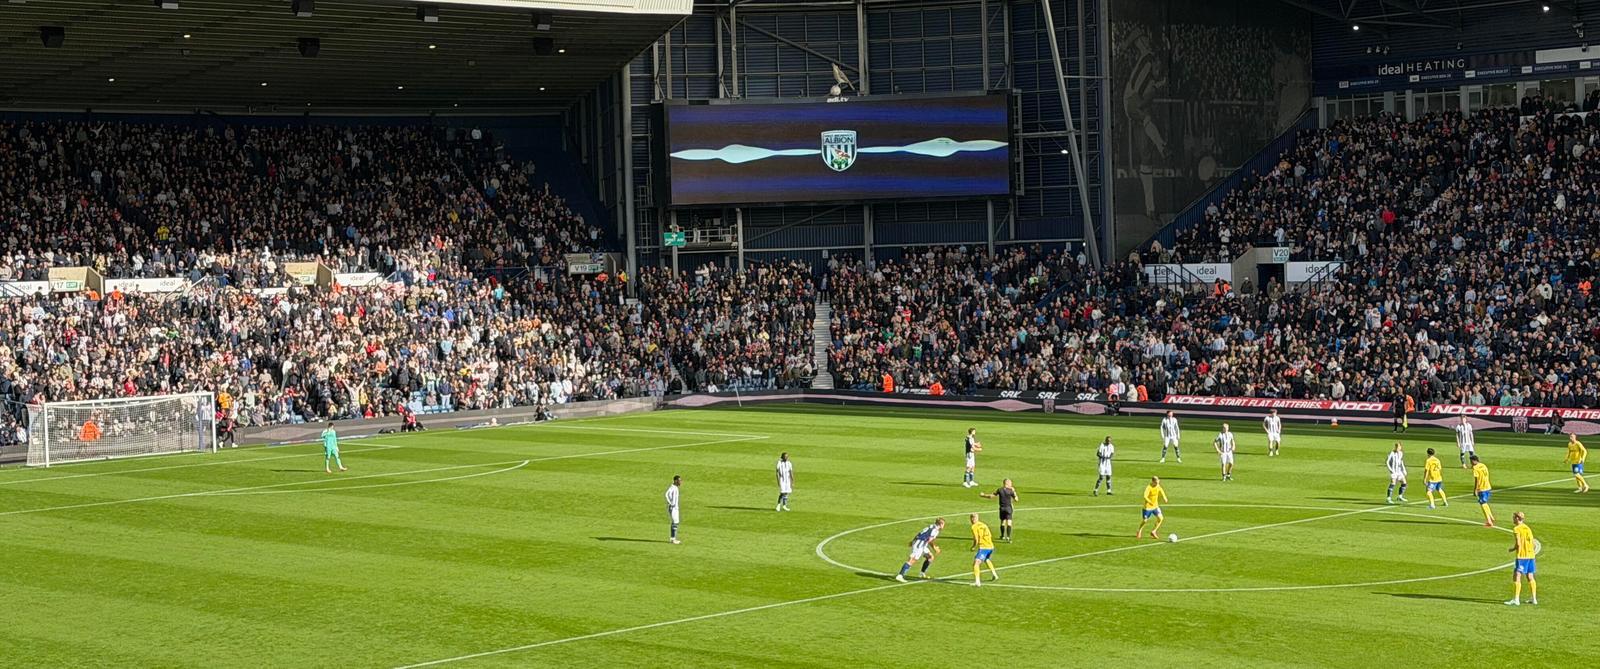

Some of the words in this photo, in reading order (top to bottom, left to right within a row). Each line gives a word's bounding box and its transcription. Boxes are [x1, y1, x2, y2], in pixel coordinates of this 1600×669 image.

[1378, 63, 1403, 76] ideal
[1406, 58, 1465, 73] HEATING
[1196, 265, 1216, 275] ideal
[119, 280, 134, 288] ideal
[1168, 396, 1215, 405] NOCO
[1218, 398, 1248, 407] START
[1250, 399, 1272, 408] FLAT
[1330, 402, 1384, 411] NOCO
[1432, 406, 1492, 415] NOCO
[1494, 407, 1529, 417] START
[1532, 409, 1561, 418] FLA
[1563, 410, 1600, 420] BATTE
